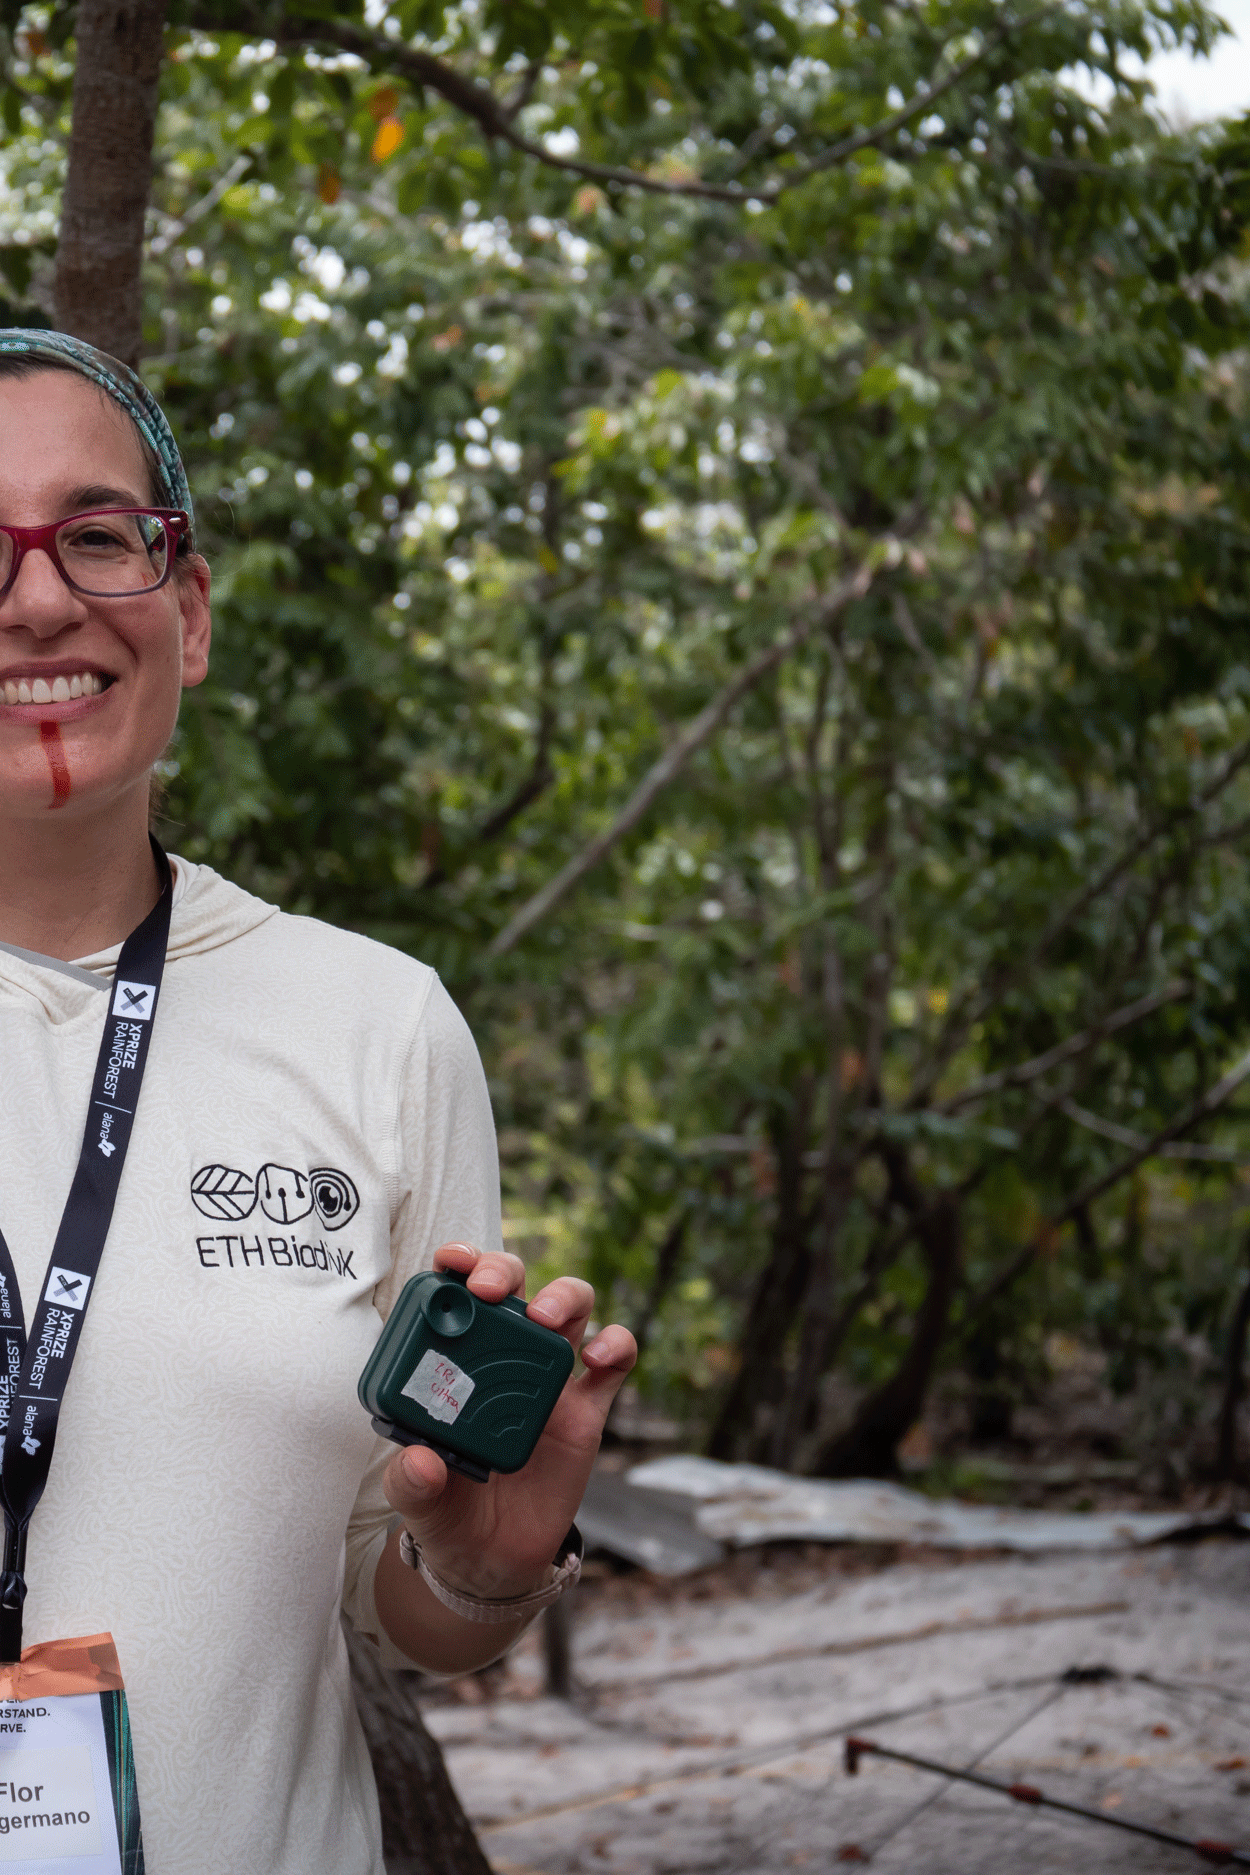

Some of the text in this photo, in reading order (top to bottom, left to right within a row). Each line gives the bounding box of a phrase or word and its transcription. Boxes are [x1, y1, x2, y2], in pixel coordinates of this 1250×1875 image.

[104, 1021, 129, 1099] RAINFOREST
[122, 1023, 143, 1070] XPRIZE
[99, 1112, 114, 1140] alana
[196, 1235, 265, 1268] ETH
[0, 1287, 12, 1319] alana
[29, 1307, 61, 1390] RAINFOREST
[50, 1310, 75, 1359] XPRIZE
[6, 1337, 21, 1396] FOREST
[22, 1405, 39, 1436] alana
